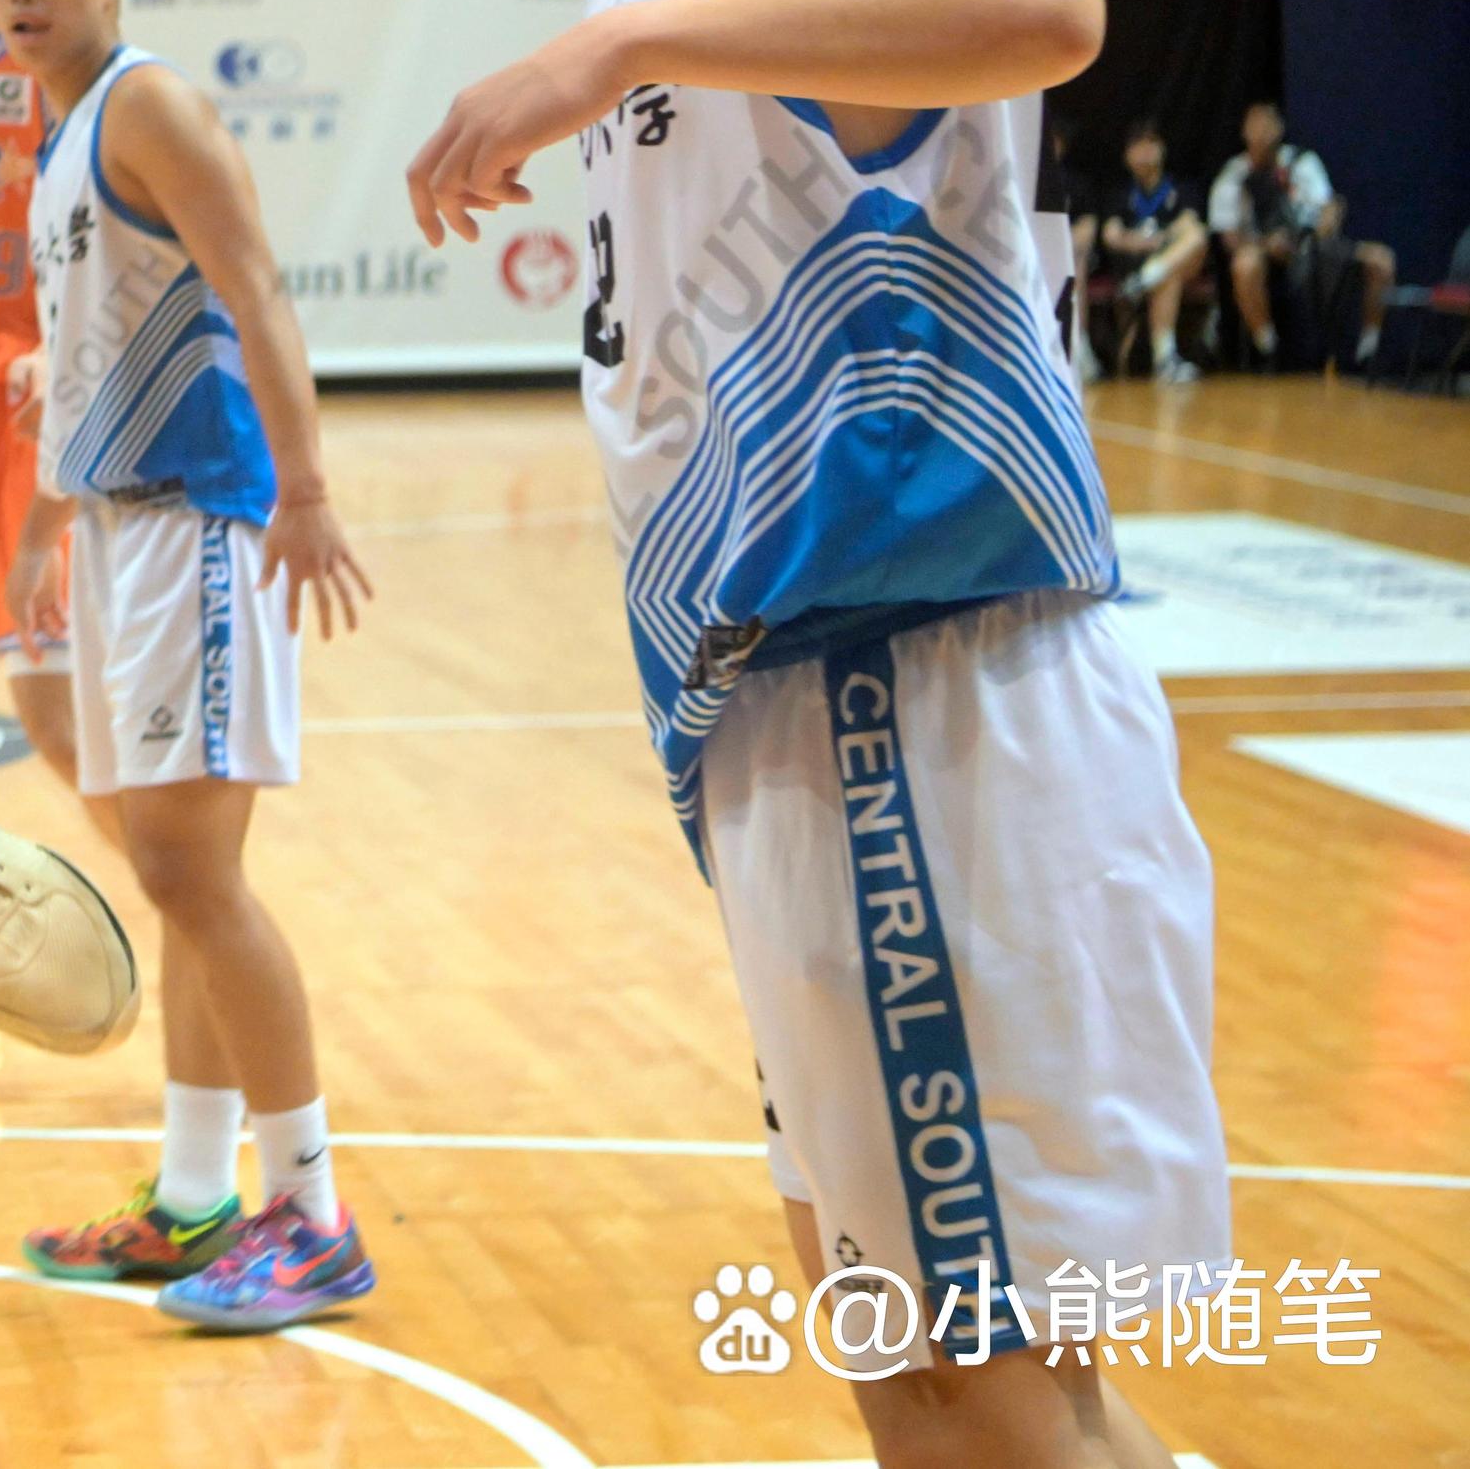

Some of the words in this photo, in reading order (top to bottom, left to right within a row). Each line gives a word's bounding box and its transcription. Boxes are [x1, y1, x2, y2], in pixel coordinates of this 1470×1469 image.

[635, 127, 851, 461] SOUTH
[838, 671, 948, 1053] CENTRAL
[899, 1070, 1013, 1340] SOUTH
